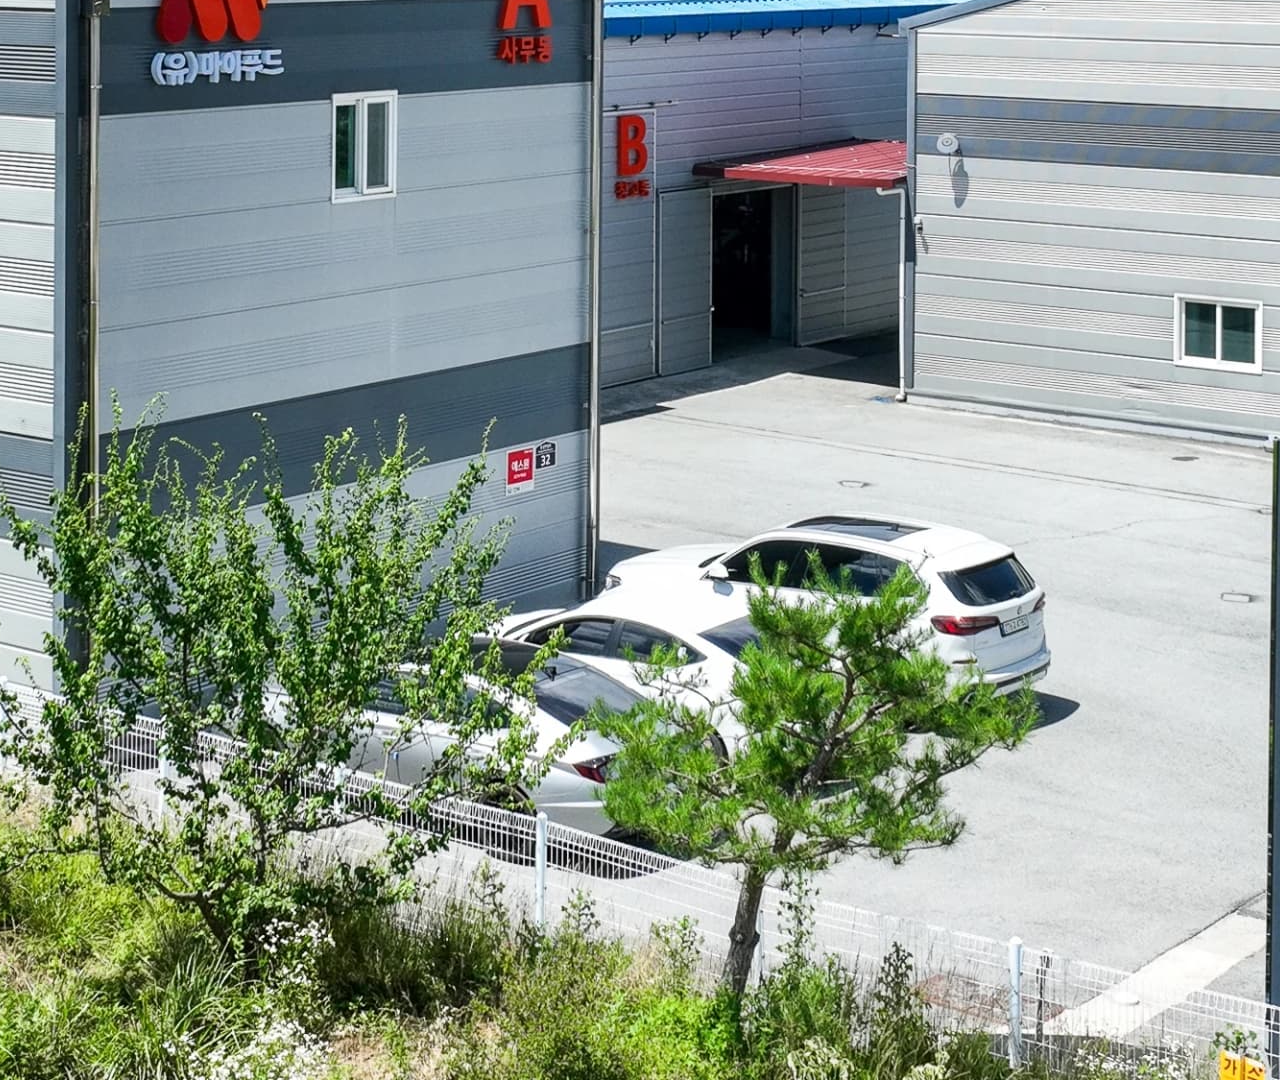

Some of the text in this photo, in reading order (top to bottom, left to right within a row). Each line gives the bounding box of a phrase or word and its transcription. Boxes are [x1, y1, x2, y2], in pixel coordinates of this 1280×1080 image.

[499, 36, 553, 64] 사무동
[151, 49, 285, 86] (유)마이푸드
[616, 114, 648, 176] B
[540, 454, 551, 467] 32
